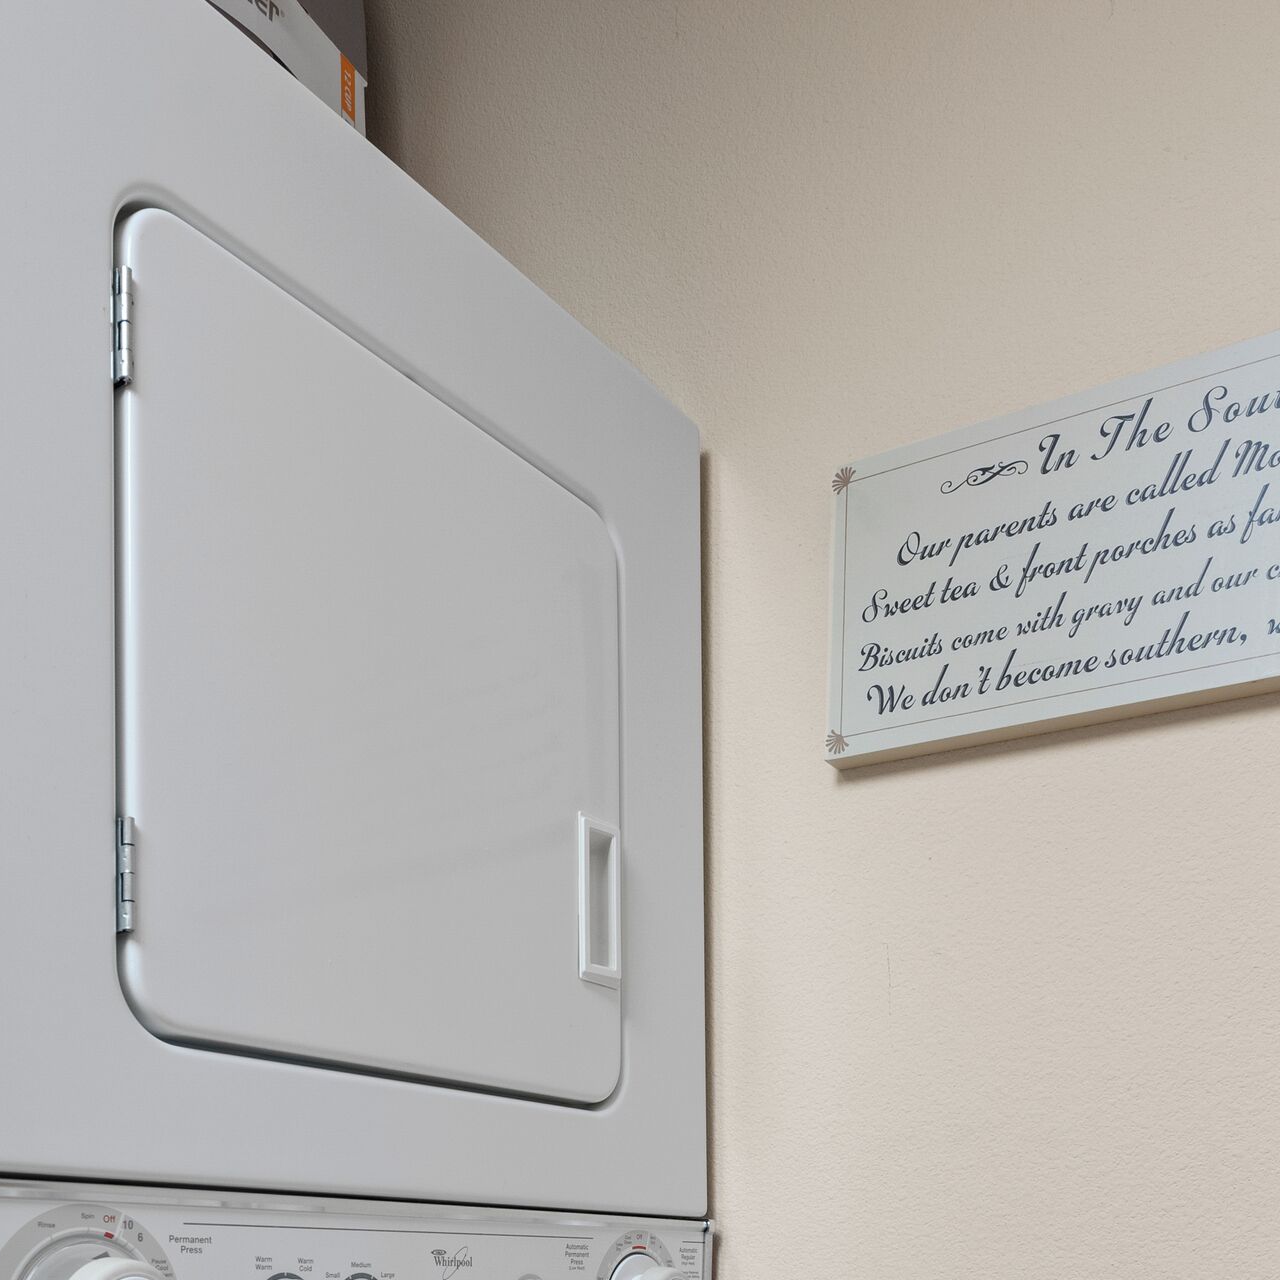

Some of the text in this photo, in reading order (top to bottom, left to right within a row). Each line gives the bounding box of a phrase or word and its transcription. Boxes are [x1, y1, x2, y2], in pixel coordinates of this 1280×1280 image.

[1038, 434, 1080, 475] In
[1090, 397, 1175, 461] The
[896, 531, 951, 566] Our
[949, 501, 1057, 567] parents
[1068, 493, 1118, 521] are
[1125, 438, 1231, 505] called
[862, 581, 936, 623] Sweet
[940, 577, 981, 604] tea
[989, 564, 1013, 591] &
[1015, 543, 1089, 598] front
[1084, 507, 1196, 583] porches
[1207, 514, 1237, 540] as
[858, 632, 943, 672] Biscuits
[951, 624, 1009, 651] come
[1016, 591, 1067, 636] with
[1068, 595, 1143, 639] gravy
[1151, 556, 1213, 606] and
[1210, 567, 1258, 592] our
[866, 684, 916, 715] We
[921, 663, 992, 708] don't
[995, 648, 1100, 691] become
[1104, 610, 1248, 668] southern,
[103, 1215, 116, 1223] Off
[123, 1220, 133, 1230] 10
[138, 1233, 143, 1242] 6
[169, 1235, 212, 1244] Permanent
[181, 1246, 203, 1254] Press
[433, 1256, 473, 1269] Whirlpool
